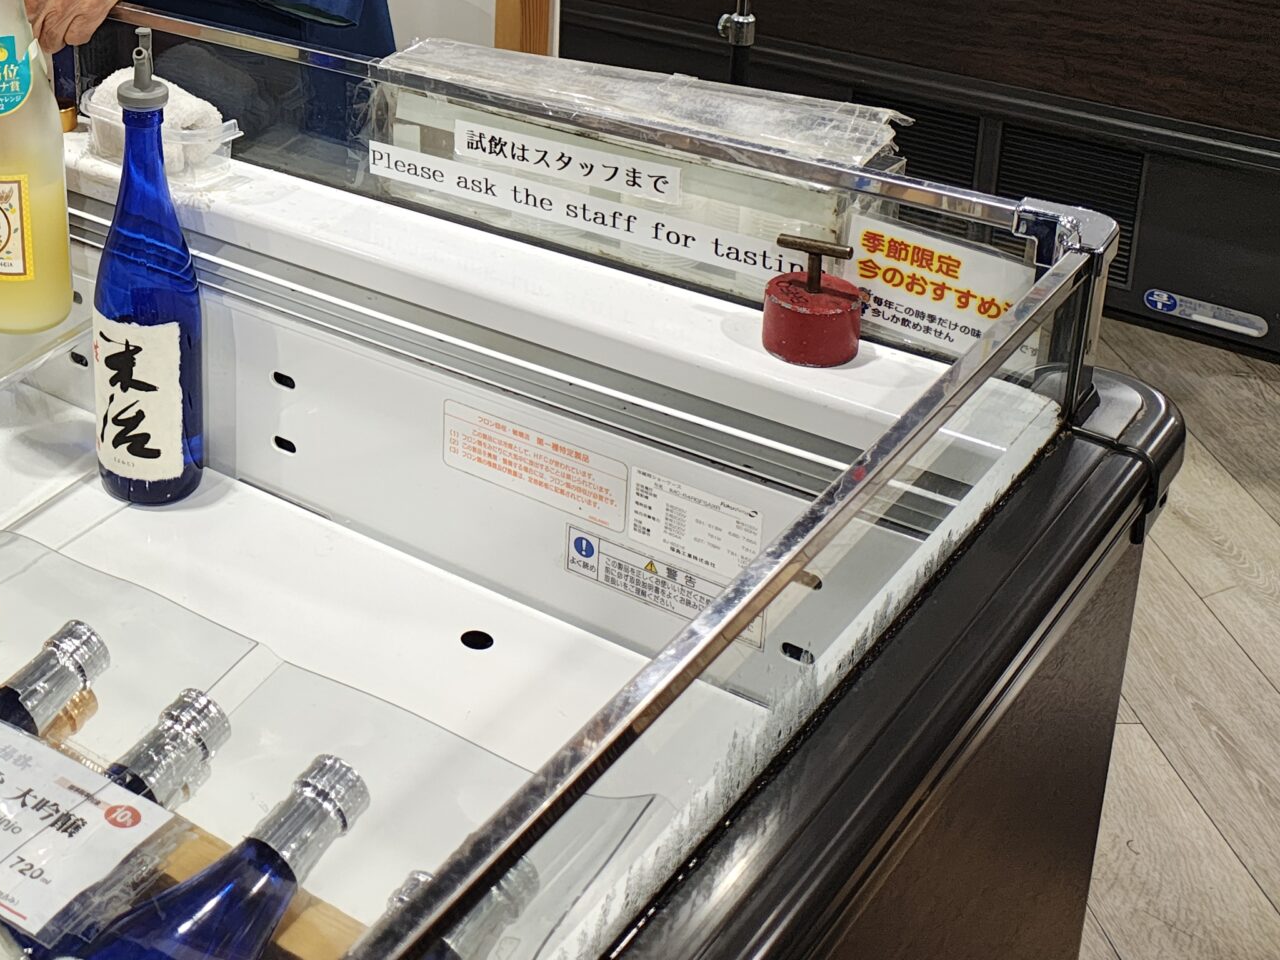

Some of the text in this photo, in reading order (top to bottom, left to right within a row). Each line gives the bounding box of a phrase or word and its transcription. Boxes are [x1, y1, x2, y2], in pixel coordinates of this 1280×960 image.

[465, 128, 671, 195] 試飲はスタッフまで
[370, 149, 446, 184] Please
[456, 173, 498, 198] ask
[510, 184, 554, 212] the
[565, 204, 638, 235] staff
[651, 221, 698, 251] for
[860, 230, 963, 280] 季節限定
[870, 307, 956, 344] 今しか飲めません
[873, 294, 983, 340] 毎年この時季だけの味
[98, 329, 162, 460] 米治
[569, 556, 597, 573] よく読め
[665, 566, 698, 589] 警告
[6, 787, 89, 839] 大吟醸
[7, 855, 52, 887] 720ml
